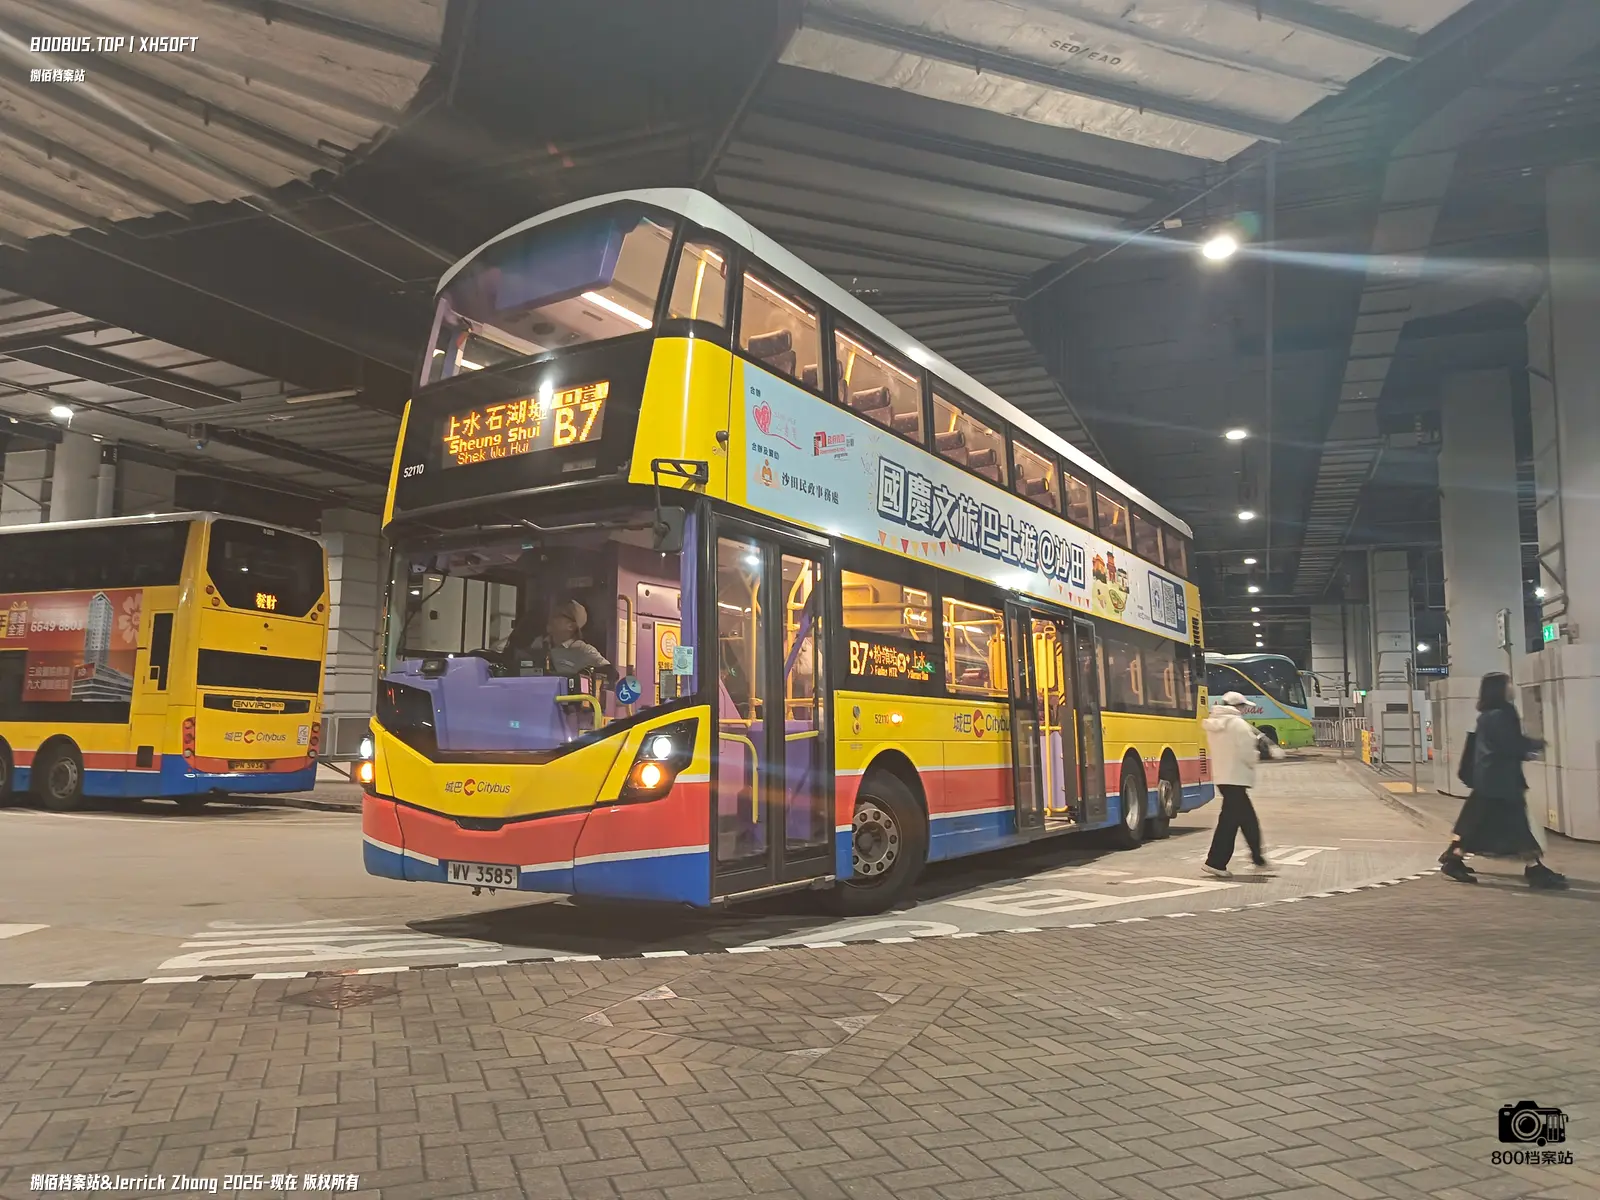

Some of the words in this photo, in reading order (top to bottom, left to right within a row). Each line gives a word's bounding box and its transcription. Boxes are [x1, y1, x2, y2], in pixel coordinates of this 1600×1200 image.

[553, 400, 602, 447] B7
[449, 433, 502, 454] Sheung
[508, 422, 541, 443] Shui
[457, 449, 487, 465] Shek
[490, 447, 506, 459] Wu
[510, 440, 529, 455] Hui
[403, 464, 425, 478] 52110
[876, 456, 1087, 590] 國慶文旅巴士遊@沙田
[849, 640, 869, 676] B7
[953, 713, 972, 734] 城巴
[985, 714, 1011, 734] Citybu
[256, 731, 286, 743] Citybus
[445, 781, 463, 793] 城巴
[477, 781, 511, 793] Citybus
[453, 863, 470, 881] WV
[475, 866, 513, 885] 3585
